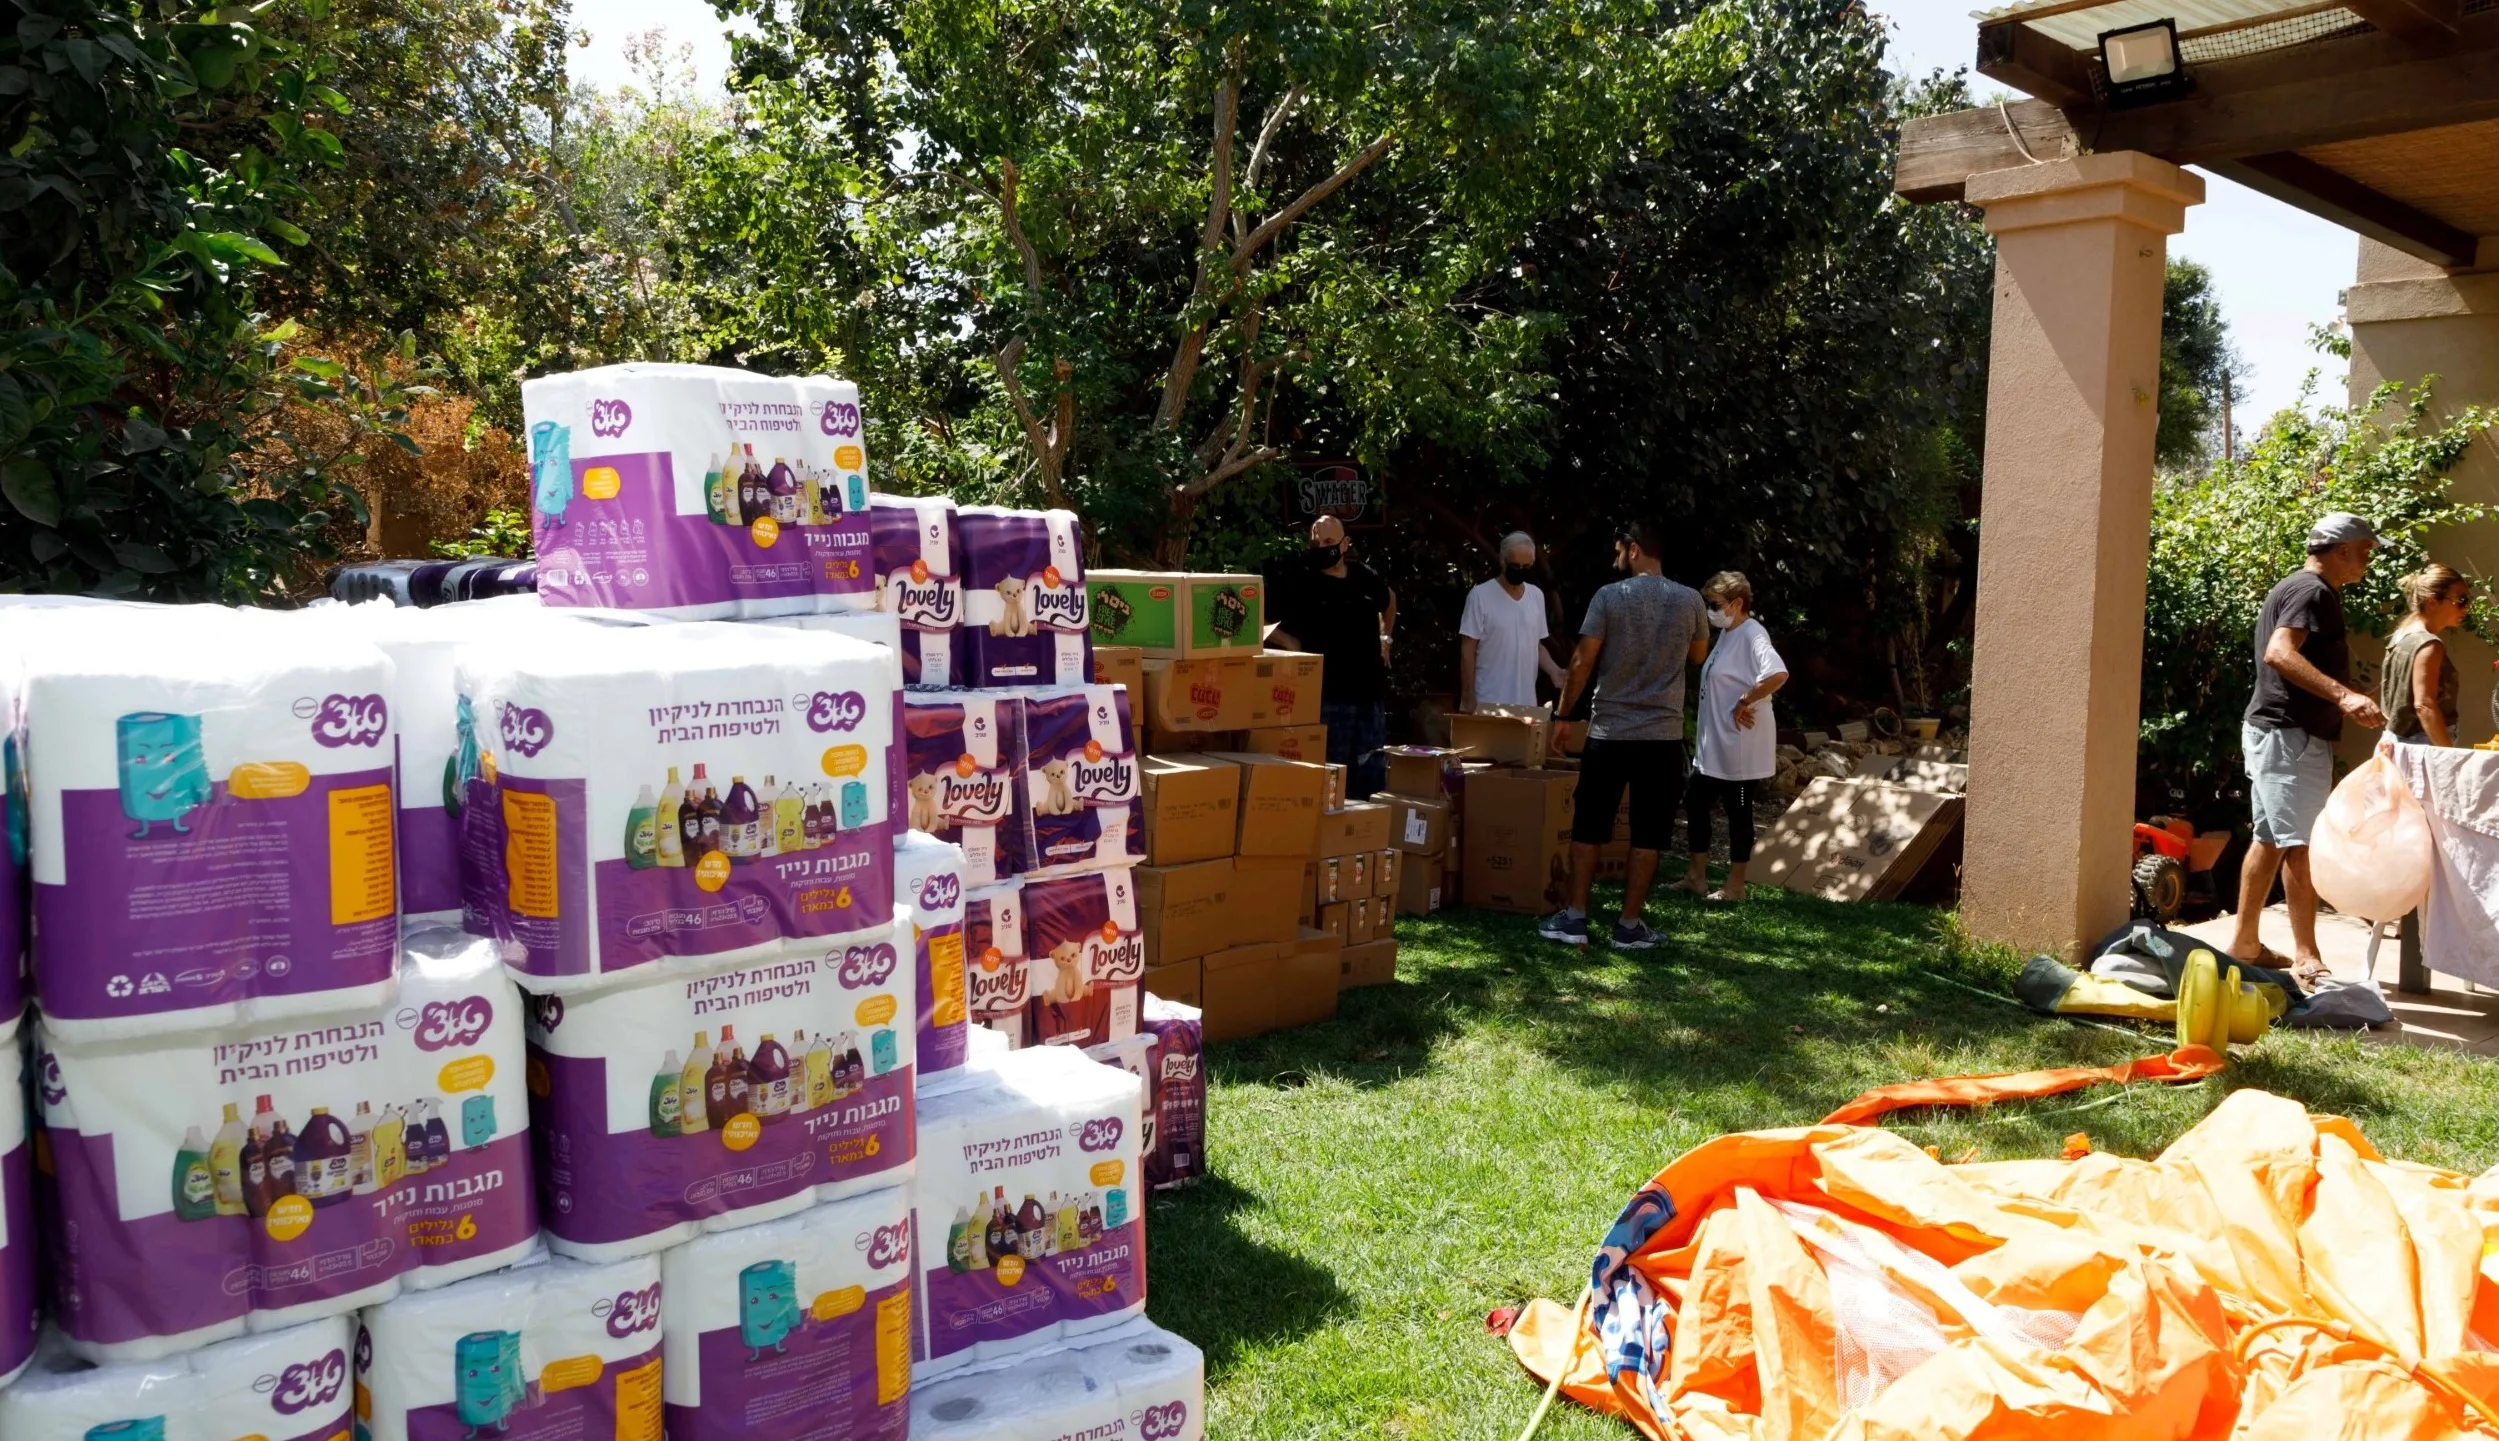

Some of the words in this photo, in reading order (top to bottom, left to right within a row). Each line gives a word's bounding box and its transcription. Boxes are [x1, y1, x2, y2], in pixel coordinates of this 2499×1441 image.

[763, 403, 803, 416] הנבחרת
[804, 533, 832, 547] נייר
[833, 532, 870, 547] מגבות
[848, 560, 860, 579] 6
[895, 578, 955, 623] lovely
[1032, 583, 1085, 625] lovely
[649, 700, 712, 726] לניקיון
[716, 698, 784, 717] הנבחרת
[657, 725, 704, 744] הבית
[709, 718, 780, 738] ולטיפוח
[1071, 756, 1131, 800] lovely
[941, 770, 1003, 817] lovely
[776, 860, 810, 879] נייר
[815, 852, 870, 874] מגבות
[836, 886, 852, 909] 6
[685, 913, 702, 925] 46
[1090, 934, 1141, 981] lovely
[751, 960, 815, 984] הנבחרת
[686, 971, 746, 999] לניקיון
[744, 980, 810, 1006] ולטיפוח
[970, 961, 1028, 1010] lovely
[694, 995, 740, 1015] הבית
[294, 1021, 385, 1051] הנבחרת
[213, 1035, 288, 1067] לניקיון
[286, 1044, 378, 1076] ולטיפוח
[219, 1062, 279, 1086] הבית
[843, 1095, 900, 1125] מגבות
[804, 1111, 839, 1135] נייר
[830, 1139, 865, 1153] גלילים
[865, 1133, 880, 1156] 6
[963, 1137, 1011, 1161] לניקיון
[1013, 1128, 1062, 1150] הנבחרת
[970, 1158, 1004, 1174] הבית
[1008, 1144, 1060, 1167] ולטיפוח
[423, 1169, 504, 1203] מגבות
[737, 1173, 752, 1185] 46
[372, 1187, 417, 1218] נייר
[408, 1220, 455, 1235] גלילים
[456, 1213, 477, 1240] 6
[411, 1233, 454, 1247] במארז
[1057, 1257, 1084, 1273] נייר
[1087, 1244, 1129, 1267] מגבות
[290, 1267, 309, 1280] 46
[1103, 1274, 1116, 1293] 6
